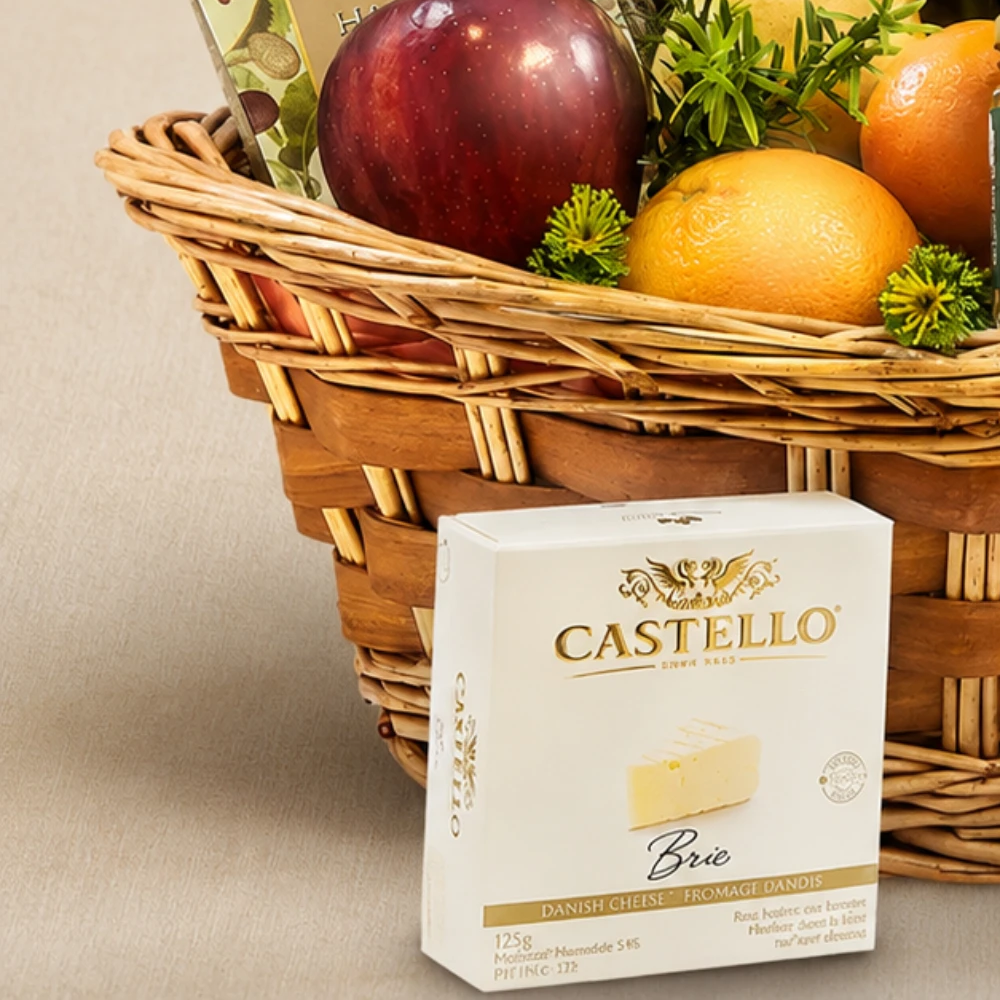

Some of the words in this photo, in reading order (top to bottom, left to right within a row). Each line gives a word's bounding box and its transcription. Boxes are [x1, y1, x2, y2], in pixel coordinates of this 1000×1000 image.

[554, 606, 837, 662] CASTELLO
[647, 828, 731, 880] Brie
[541, 901, 604, 918] DANISH
[608, 892, 665, 911] CHEESE
[684, 882, 757, 903] FROMAGE
[495, 932, 533, 951] 125g
